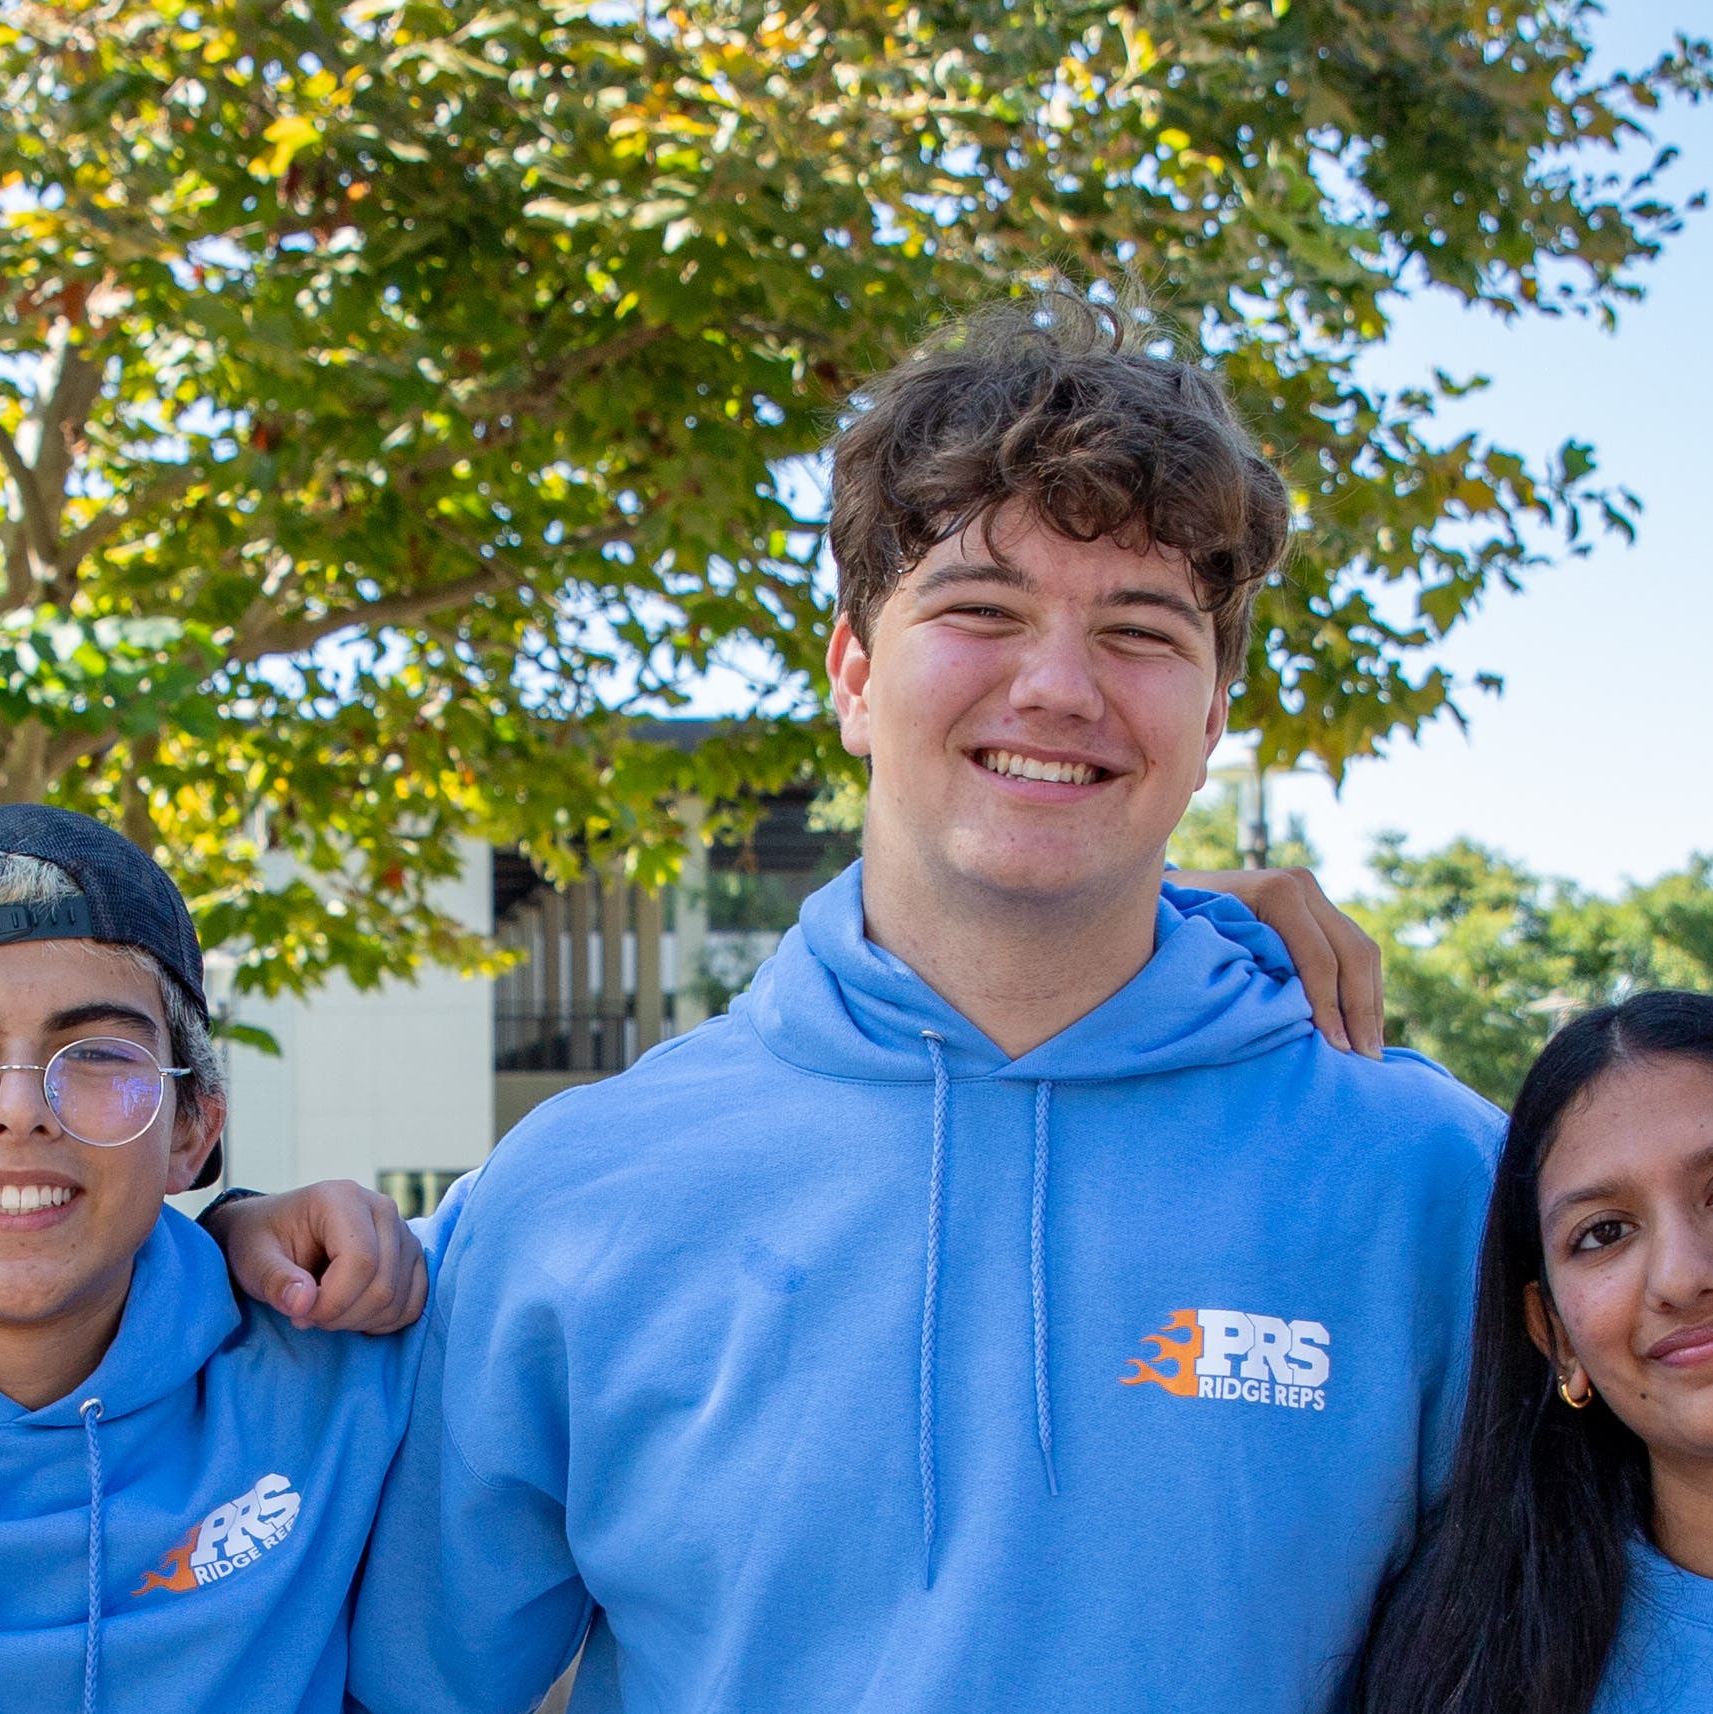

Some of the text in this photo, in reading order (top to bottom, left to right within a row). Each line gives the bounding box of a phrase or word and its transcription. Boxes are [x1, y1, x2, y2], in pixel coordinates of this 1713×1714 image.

[1195, 1309, 1330, 1388] PRS
[1198, 1376, 1326, 1412] RIDGE REPS
[191, 1473, 302, 1566] PRS
[193, 1507, 300, 1586] RIDGE REP
